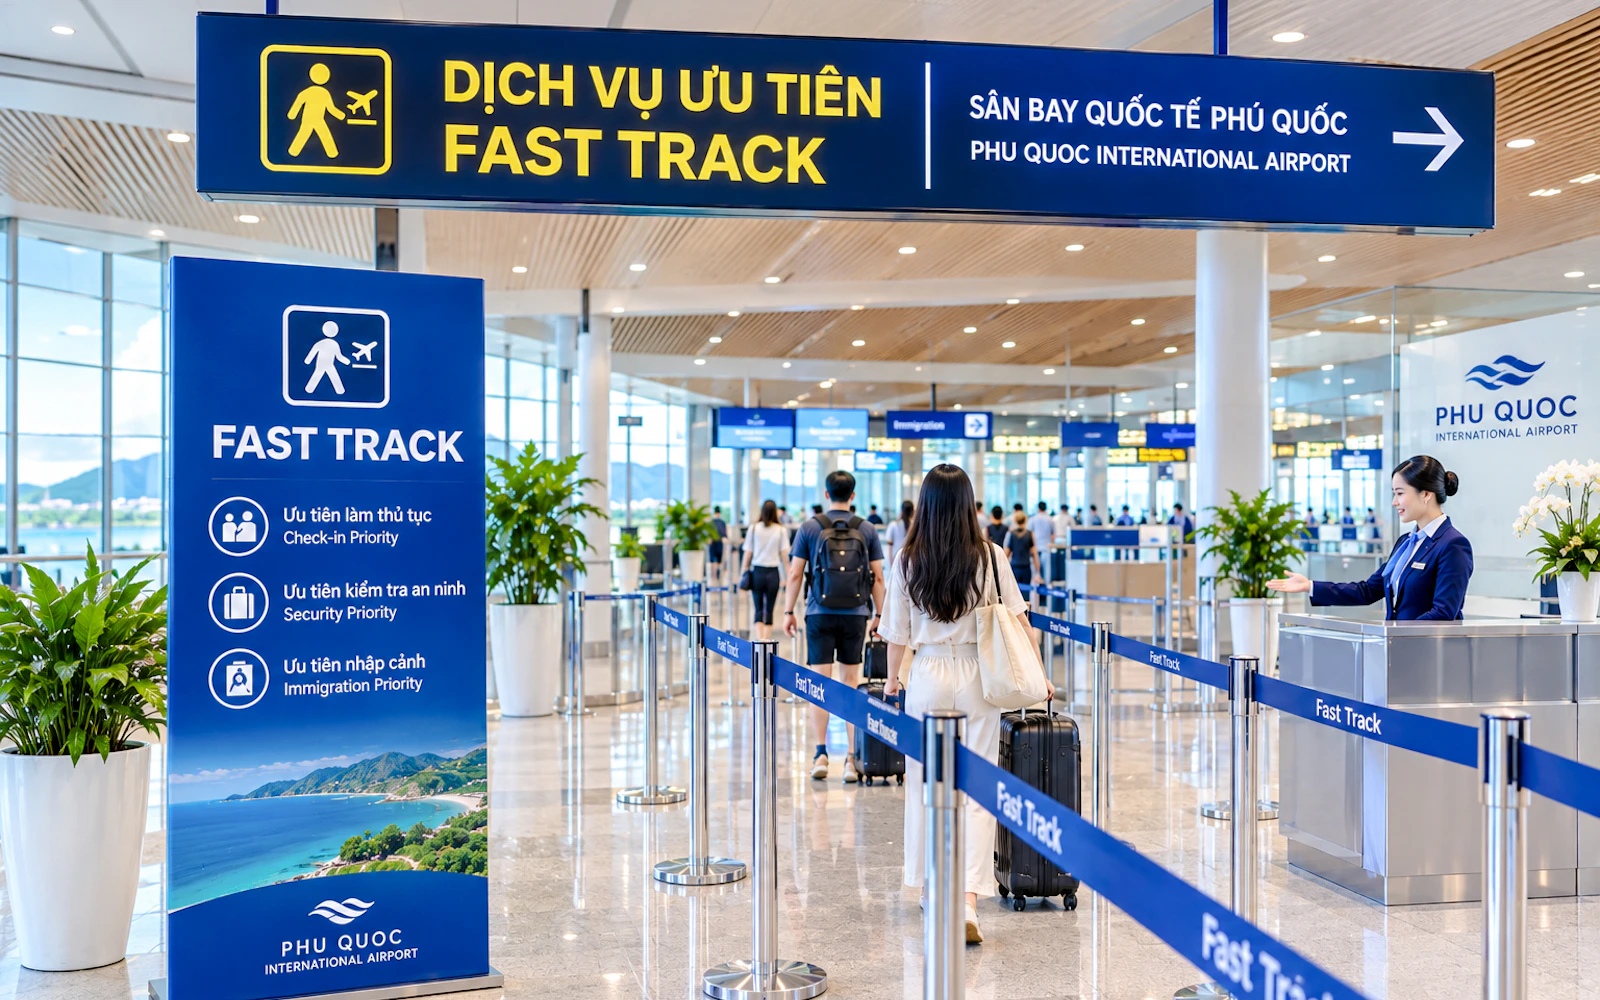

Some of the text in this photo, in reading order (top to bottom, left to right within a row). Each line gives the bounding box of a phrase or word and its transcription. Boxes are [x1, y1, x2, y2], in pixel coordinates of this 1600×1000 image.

[445, 59, 881, 121] DỊCH VỤ ƯU TIÊN
[969, 88, 1348, 136] SÂN BAY QUỐC TẾ PHÚ QUỐC
[445, 123, 827, 185] FAST TRACK
[971, 140, 1352, 173] PHU QUOC INTERNATIONAL AIRPORT
[1435, 394, 1577, 426] PHU QUOC
[213, 424, 464, 463] FAST TRACK
[1435, 423, 1578, 442] INTERNATIONAL AIRPORT
[283, 505, 432, 527] Ưu tiên làm thủ tục
[283, 530, 399, 548] Check-in Priority
[283, 580, 466, 600] Ưu tiên kiểm tra an ninh
[283, 605, 398, 624] Security Priority
[283, 653, 426, 676] Ưu tiên nhập cảnh
[284, 677, 423, 698] Immigration Priority
[1316, 698, 1382, 736] Fast Track
[996, 780, 1063, 856] Fast Track
[281, 928, 402, 958] PHU QUOC
[1201, 911, 1254, 993] Fast
[264, 947, 419, 976] INTERNATIONAL AIRPORT
